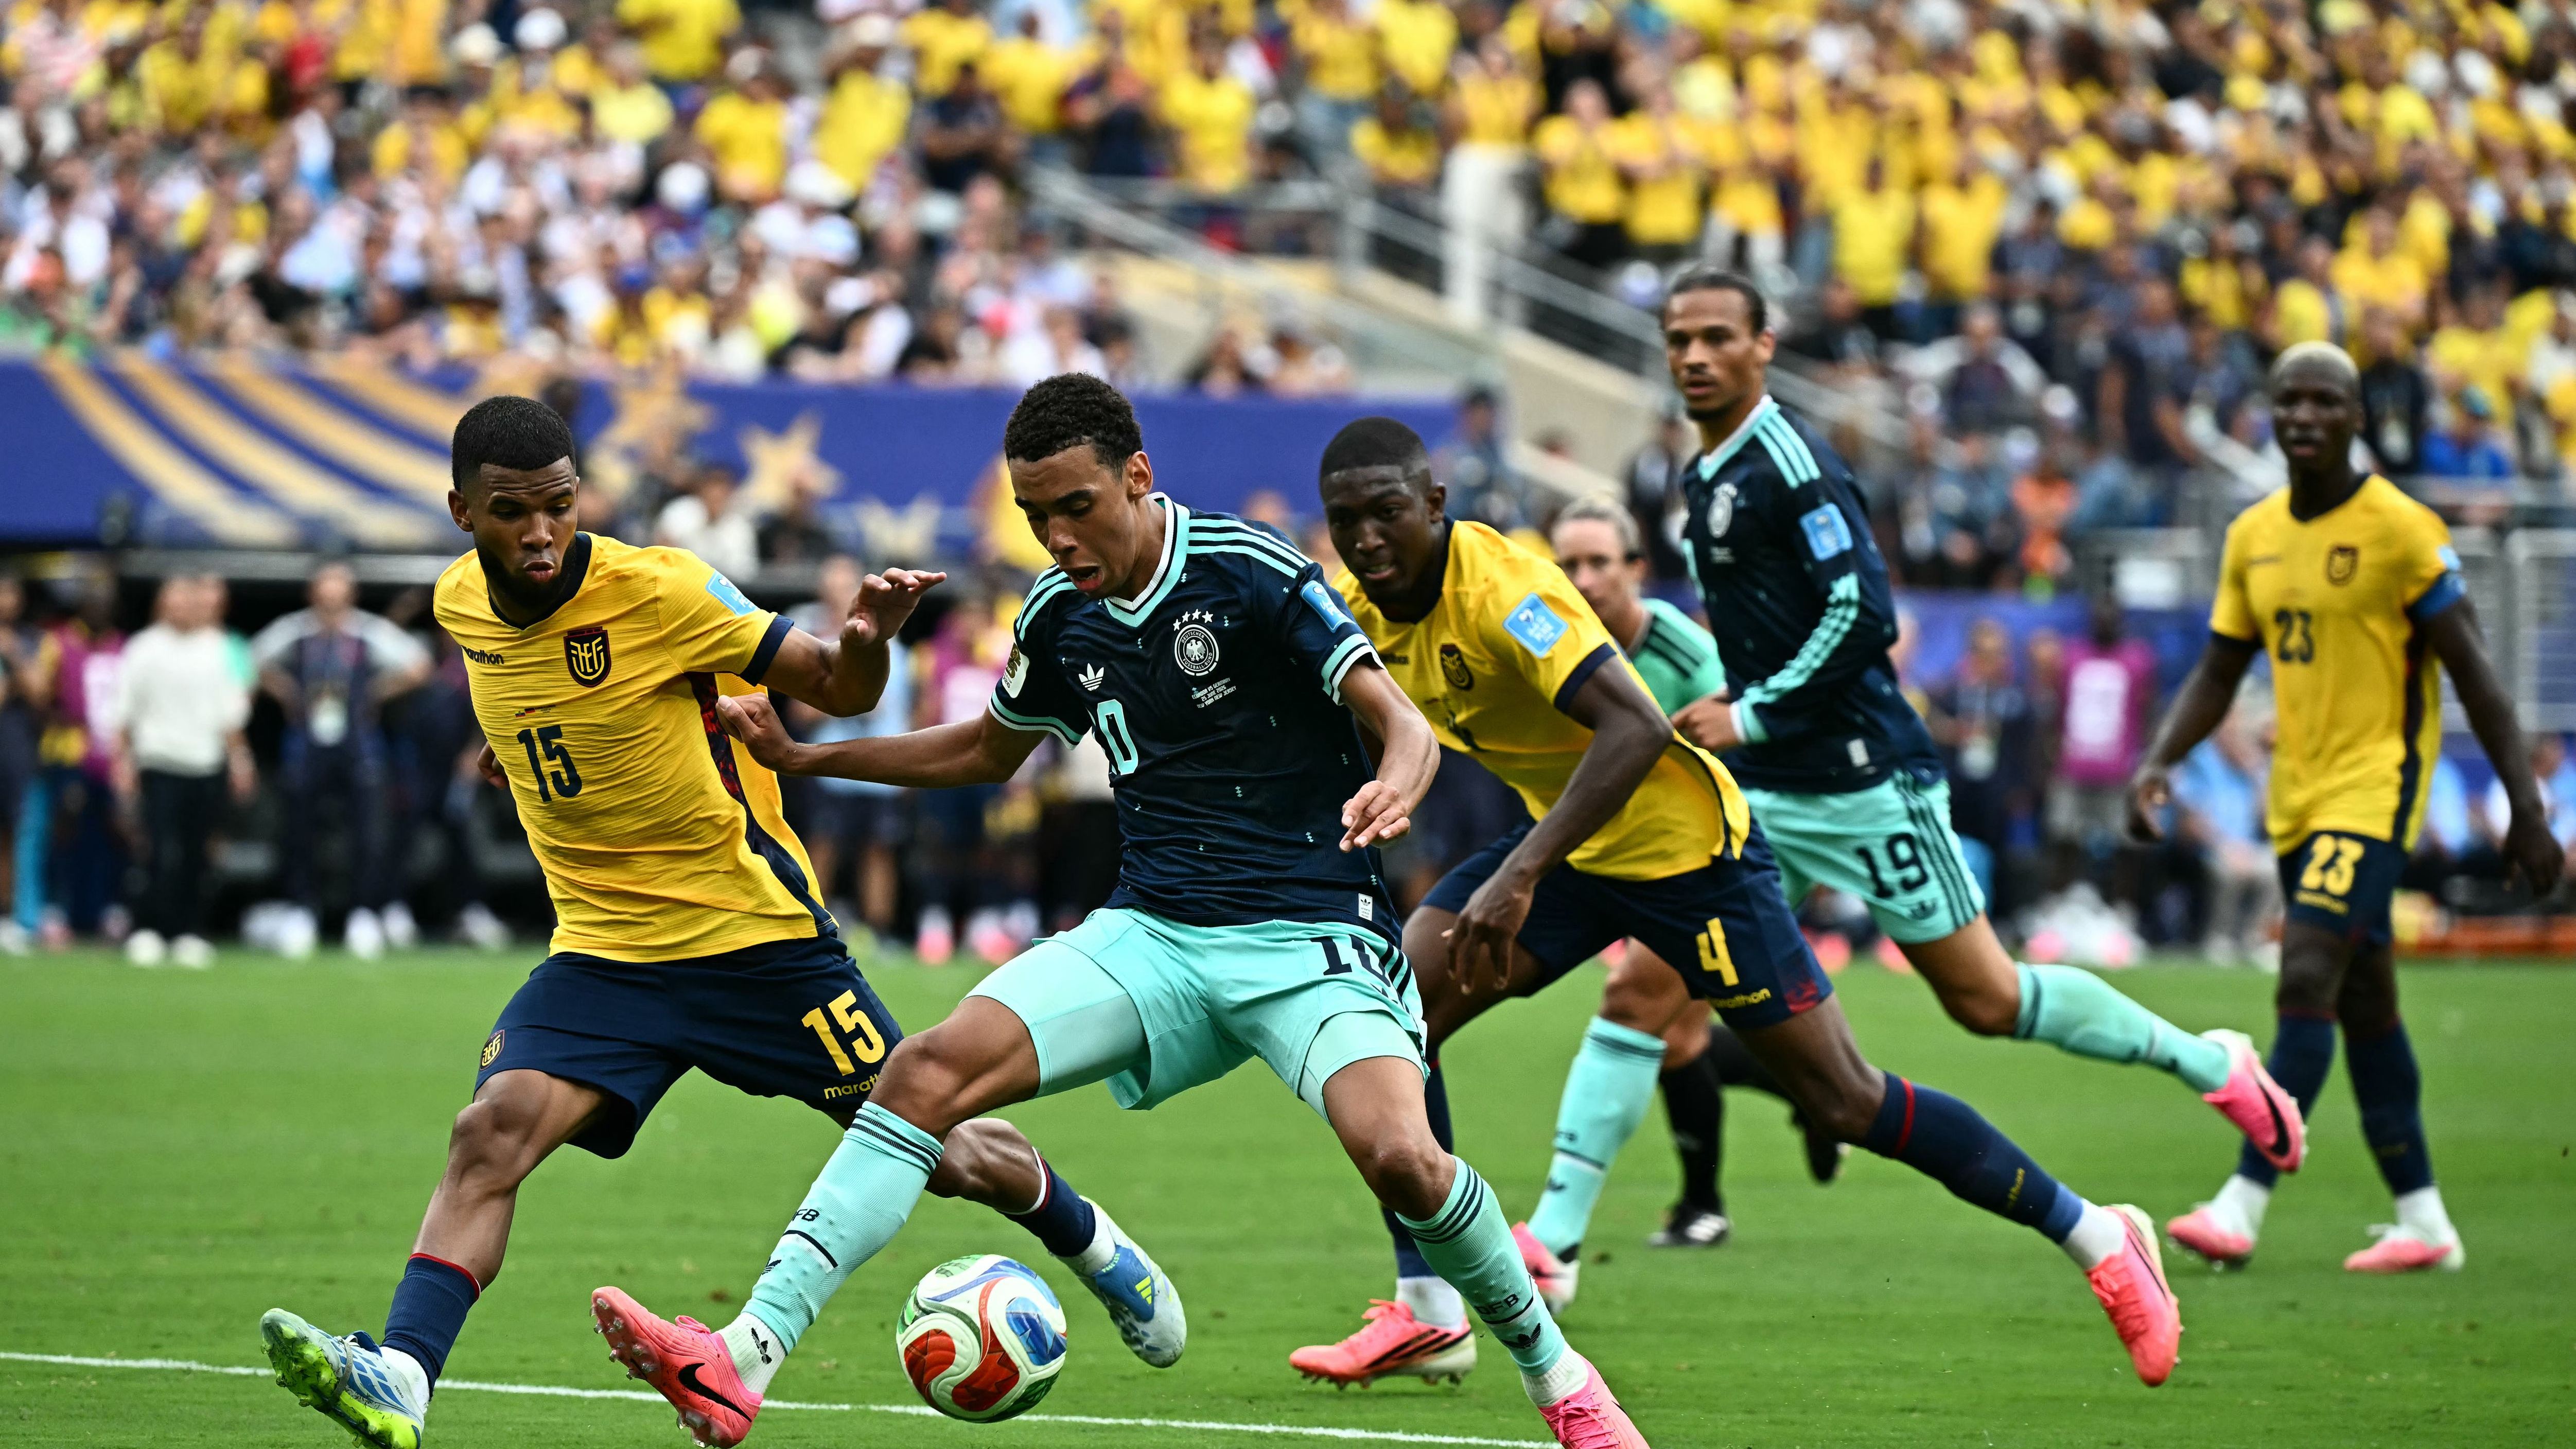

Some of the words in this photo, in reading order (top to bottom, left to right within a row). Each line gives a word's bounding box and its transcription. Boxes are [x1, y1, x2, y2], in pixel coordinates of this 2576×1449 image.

[1181, 631, 1204, 643] DEUTSCHER
[2275, 607, 2315, 662] 23
[1191, 688, 1208, 699] ECUADOR
[1213, 677, 1231, 688] GERMANY
[1204, 697, 1215, 706] YORK
[1223, 686, 1236, 696] JERSEY
[1207, 690, 1216, 699] JUNE
[1216, 685, 1226, 693] 2026
[1091, 699, 1139, 776] 0
[516, 725, 583, 802] 15
[1856, 832, 1930, 899] 19
[2301, 834, 2366, 896] 23
[1696, 917, 1739, 987] 4
[801, 989, 885, 1076] 15
[792, 1209, 819, 1222] FB
[1474, 1294, 1519, 1315] DFB
[394, 1385, 404, 1399] PEDRO
